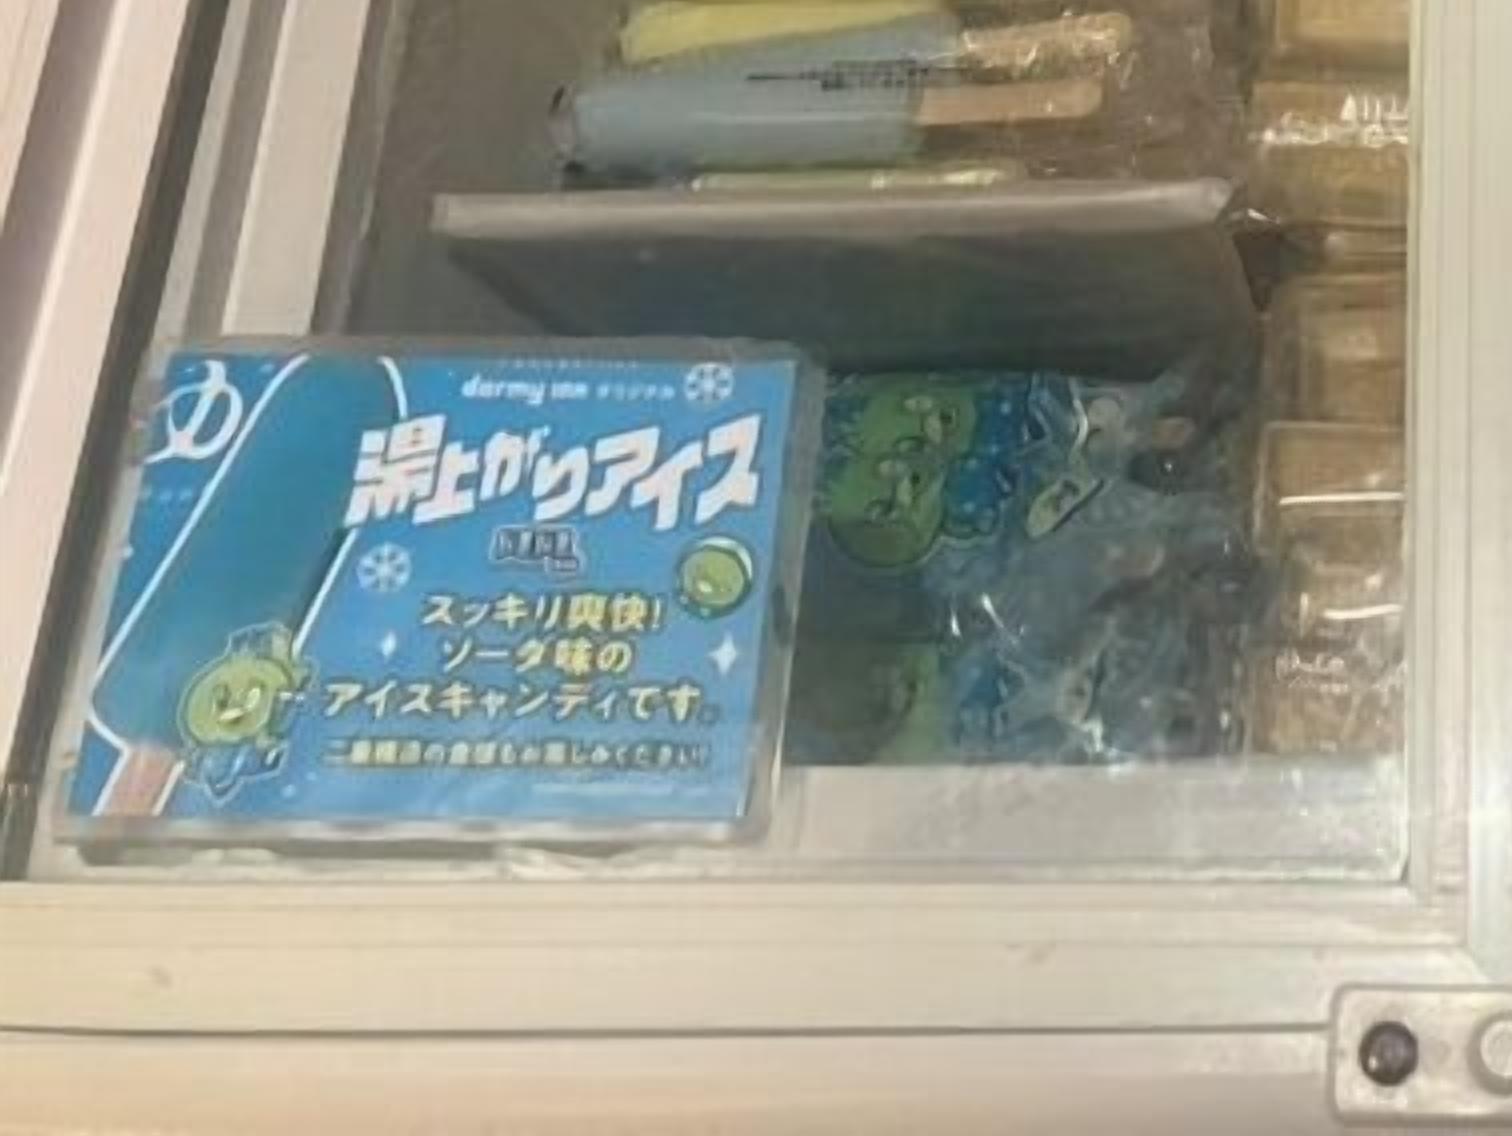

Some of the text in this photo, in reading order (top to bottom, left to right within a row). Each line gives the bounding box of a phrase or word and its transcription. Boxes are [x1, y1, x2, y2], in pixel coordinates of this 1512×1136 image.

[343, 414, 762, 531] 湯上がりアイス
[443, 636, 633, 676] ソーダ味の
